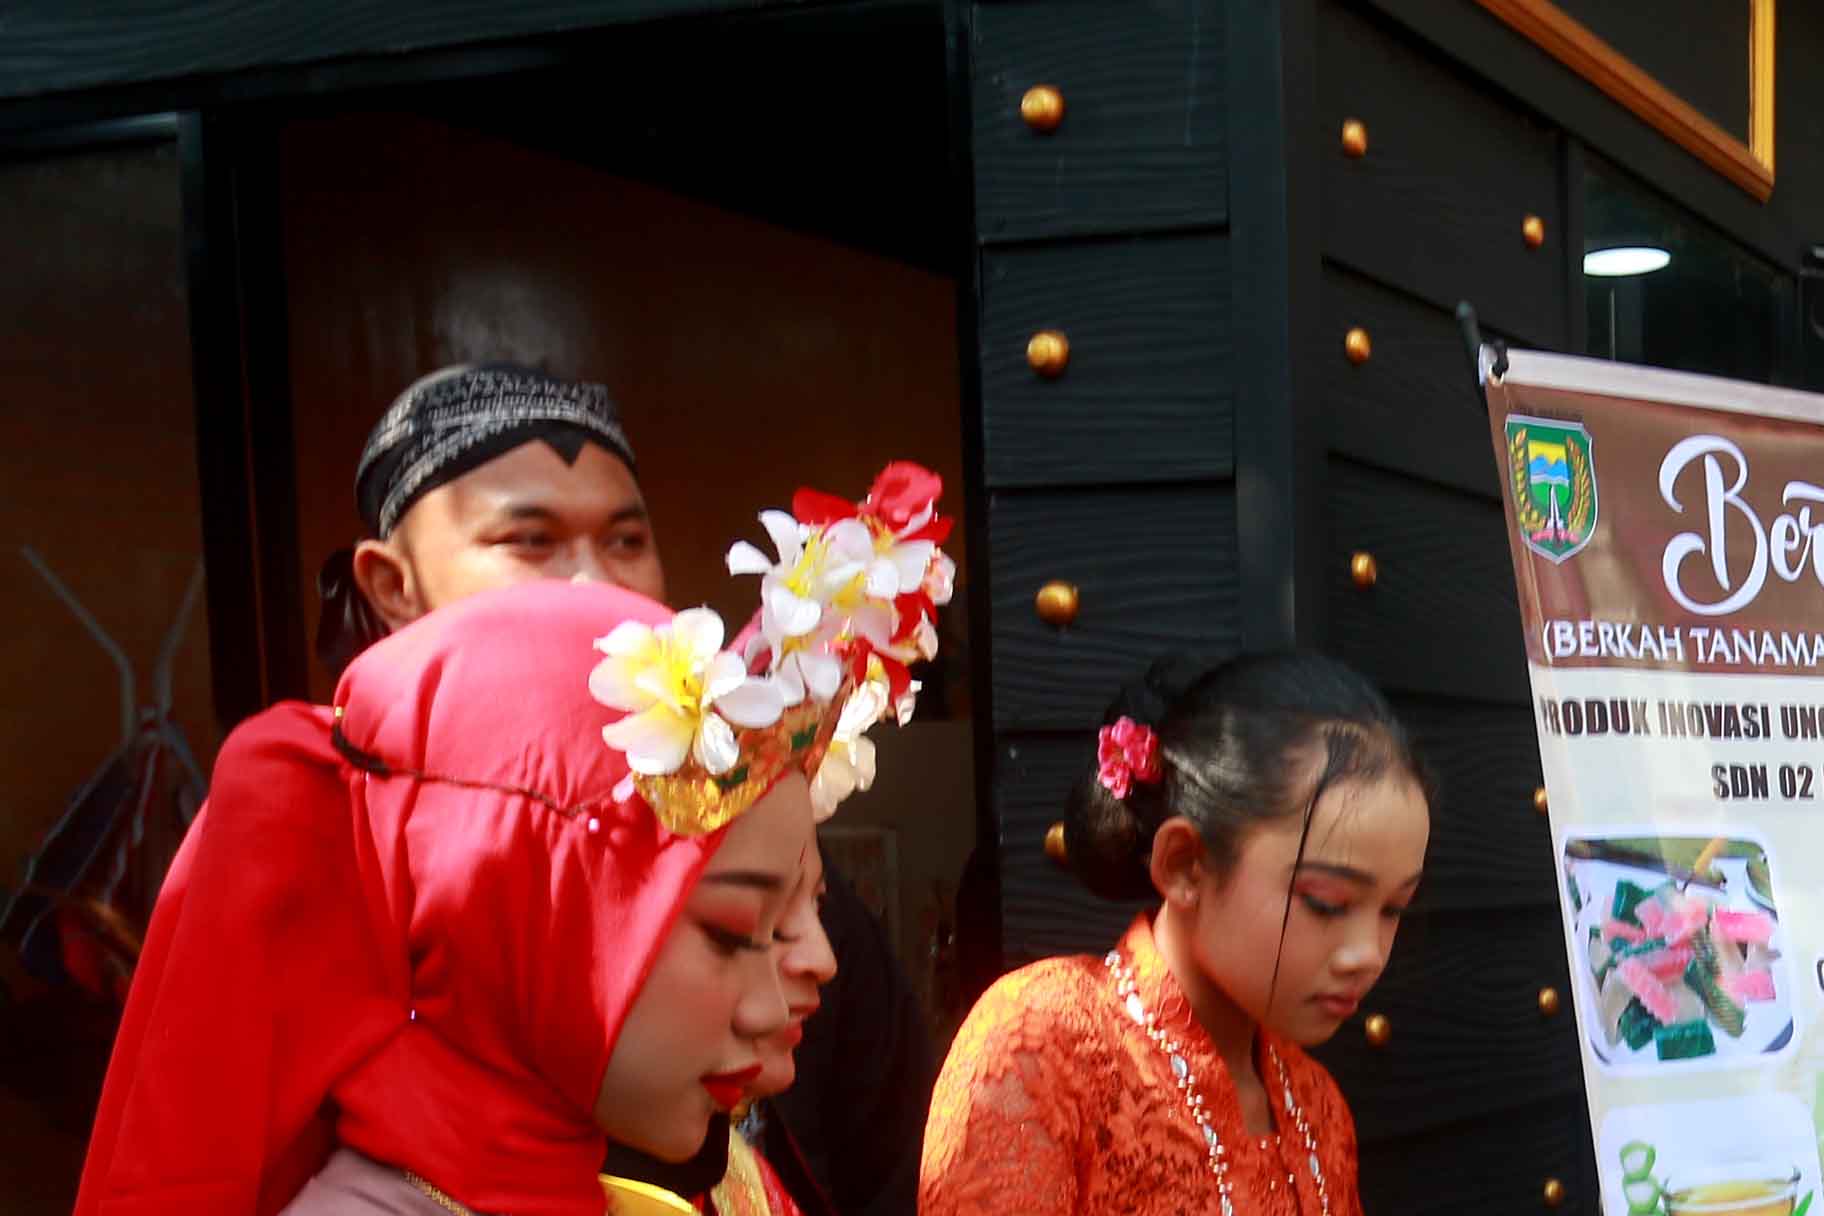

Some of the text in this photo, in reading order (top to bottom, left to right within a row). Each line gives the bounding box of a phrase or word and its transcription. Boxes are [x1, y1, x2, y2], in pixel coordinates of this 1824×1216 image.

[1543, 619, 1685, 665] (BERKAH
[1657, 701, 1772, 740] INOVASI
[1711, 763, 1769, 800] SDN
[1779, 764, 1816, 800] 02
